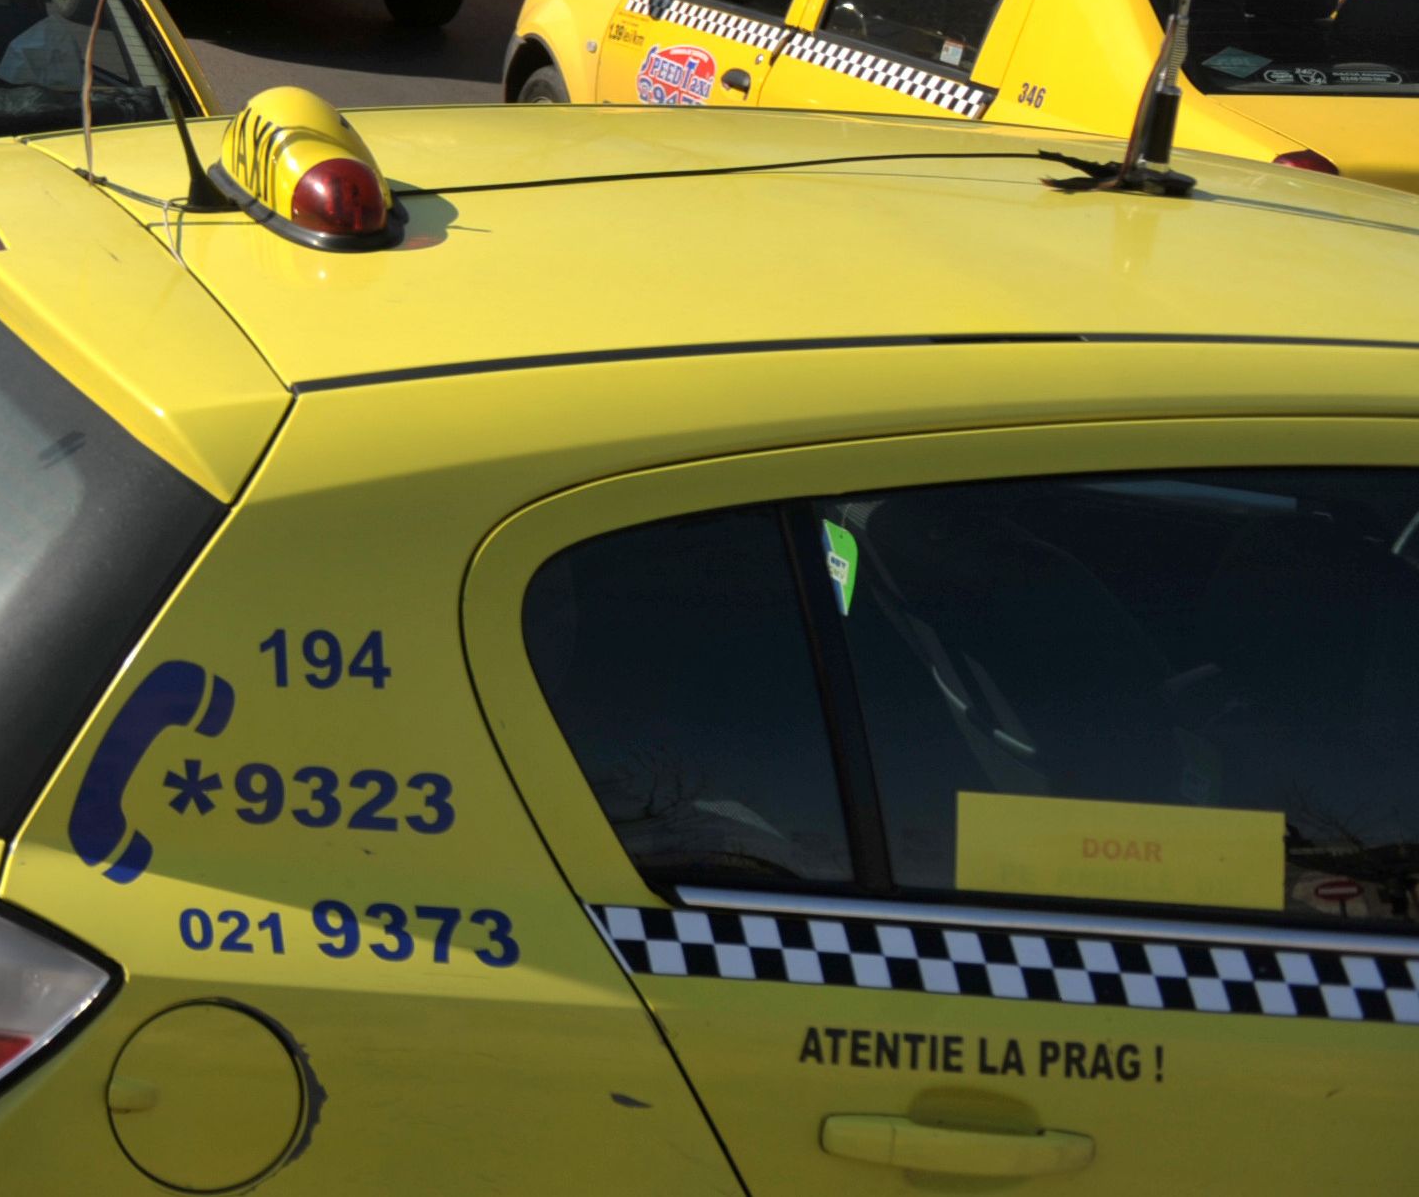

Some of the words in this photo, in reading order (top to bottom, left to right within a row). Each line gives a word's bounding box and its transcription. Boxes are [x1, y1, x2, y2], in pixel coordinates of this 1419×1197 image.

[1017, 82, 1047, 109] 346
[259, 628, 393, 691] 194
[1081, 837, 1163, 863] DOAR
[179, 908, 286, 955] 021
[311, 900, 522, 969] 9373
[799, 1026, 965, 1074] ATENTIE
[977, 1036, 1027, 1078] LA
[1038, 1039, 1143, 1083] PRAG
